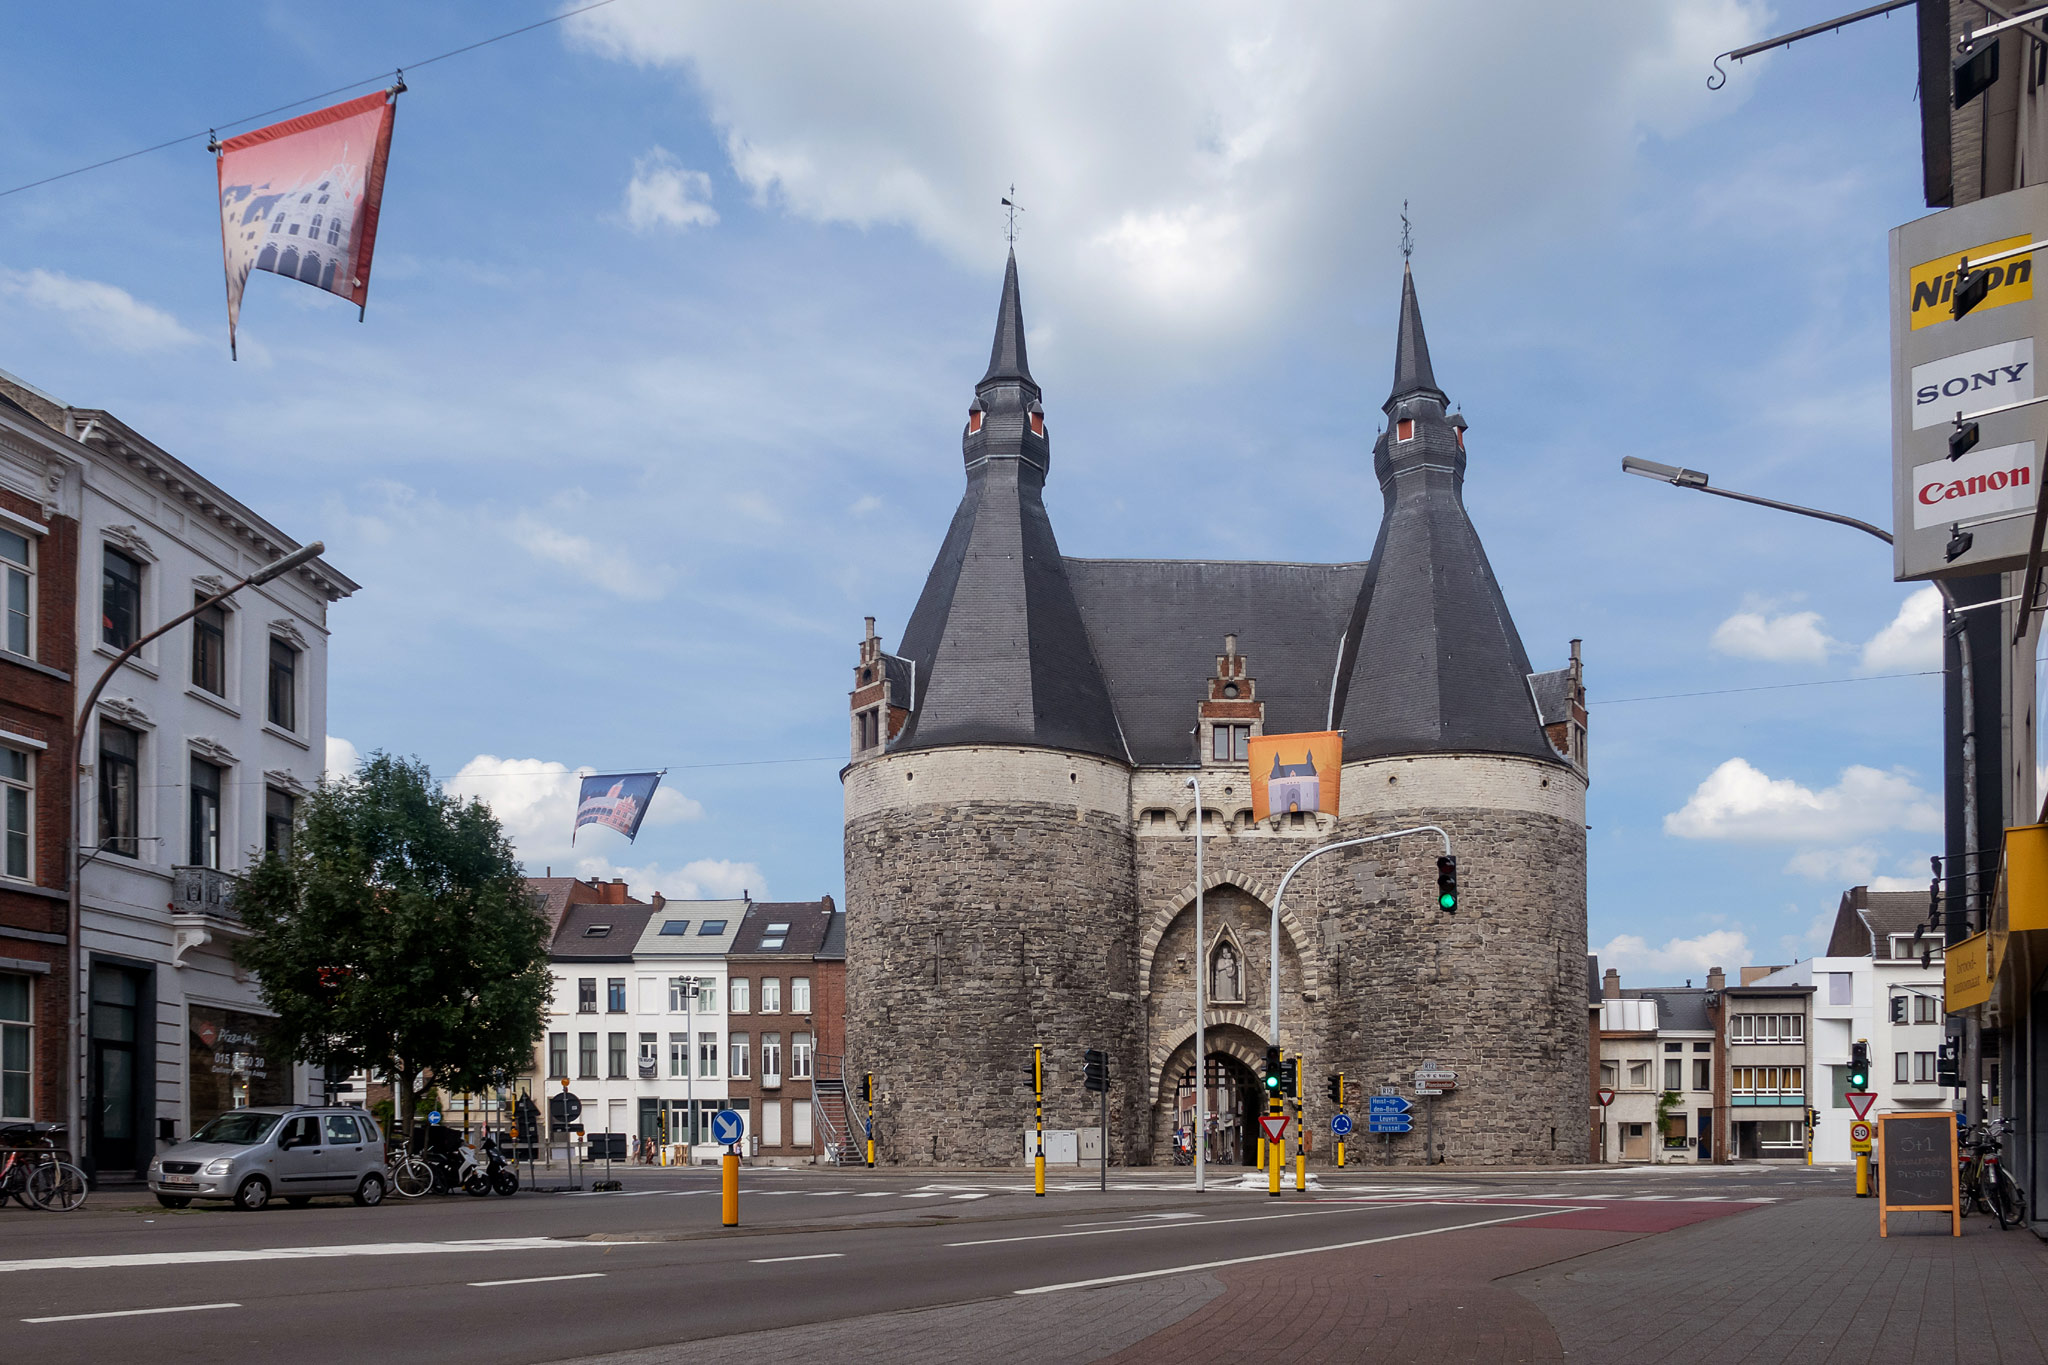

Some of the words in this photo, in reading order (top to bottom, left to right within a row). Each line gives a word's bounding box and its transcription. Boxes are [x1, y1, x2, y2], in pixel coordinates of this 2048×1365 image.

[1912, 260, 2031, 312] Nion
[1917, 362, 2029, 405] SONY
[1918, 466, 2030, 505] Canon
[217, 1028, 242, 1044] Pizza
[214, 1052, 231, 1064] 015
[1382, 1087, 1394, 1095] R12
[1379, 1114, 1398, 1122] Leuven
[1854, 1129, 1866, 1137] 50
